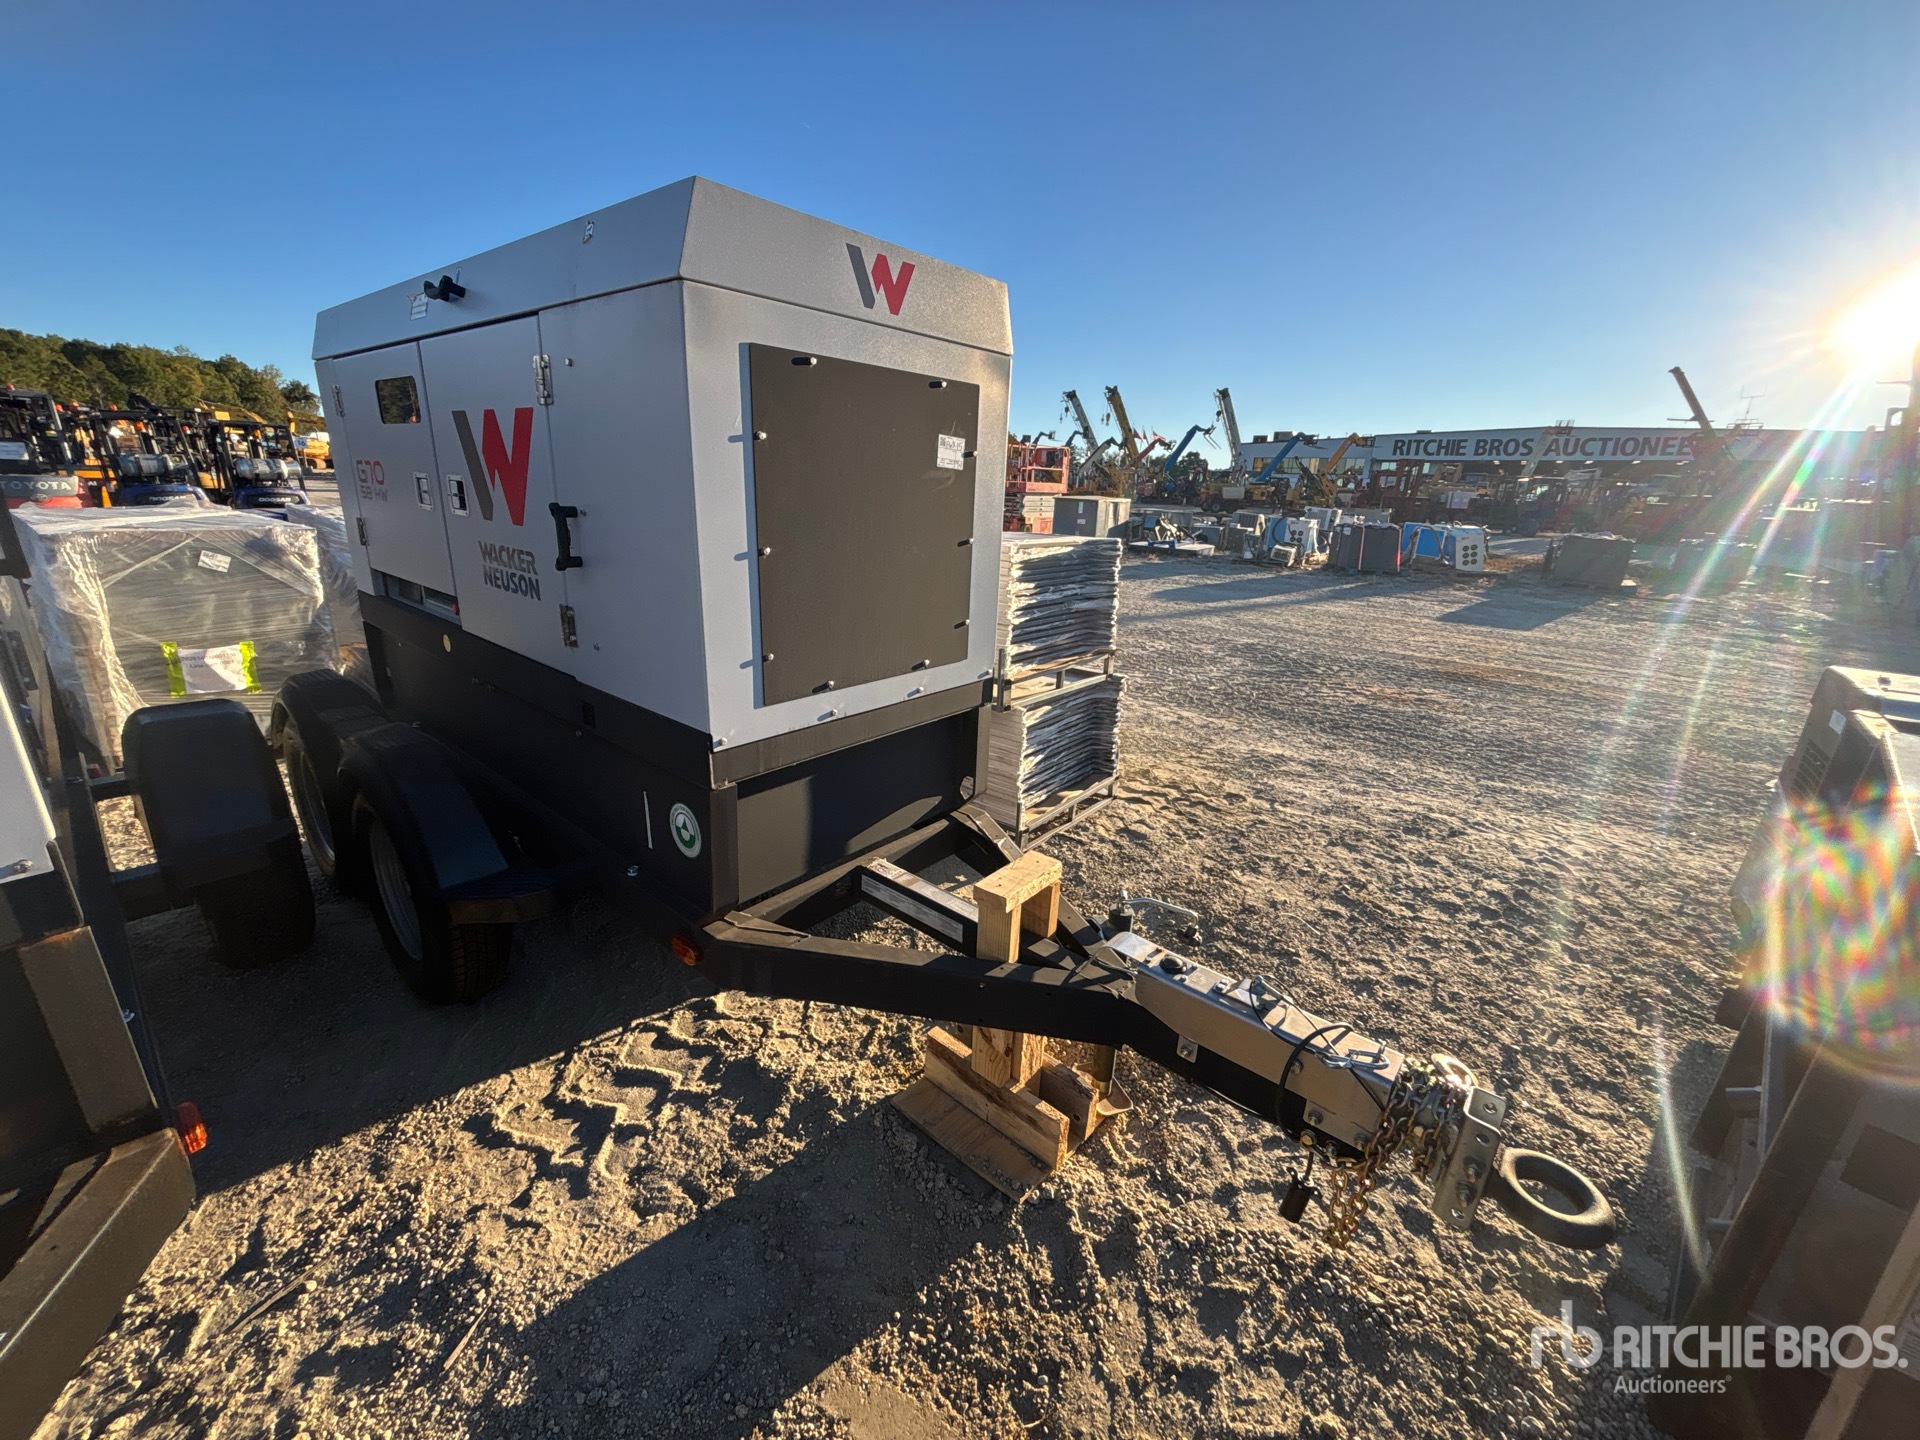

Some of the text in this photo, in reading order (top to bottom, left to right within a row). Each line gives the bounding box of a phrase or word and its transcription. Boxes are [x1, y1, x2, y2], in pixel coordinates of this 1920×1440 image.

[1392, 436, 1692, 457] RITCHIE BROS AUCTIONEE
[0, 481, 72, 491] TOYOTA
[356, 459, 385, 486] G70
[478, 540, 539, 575] WACKER
[483, 564, 542, 601] NEUSON
